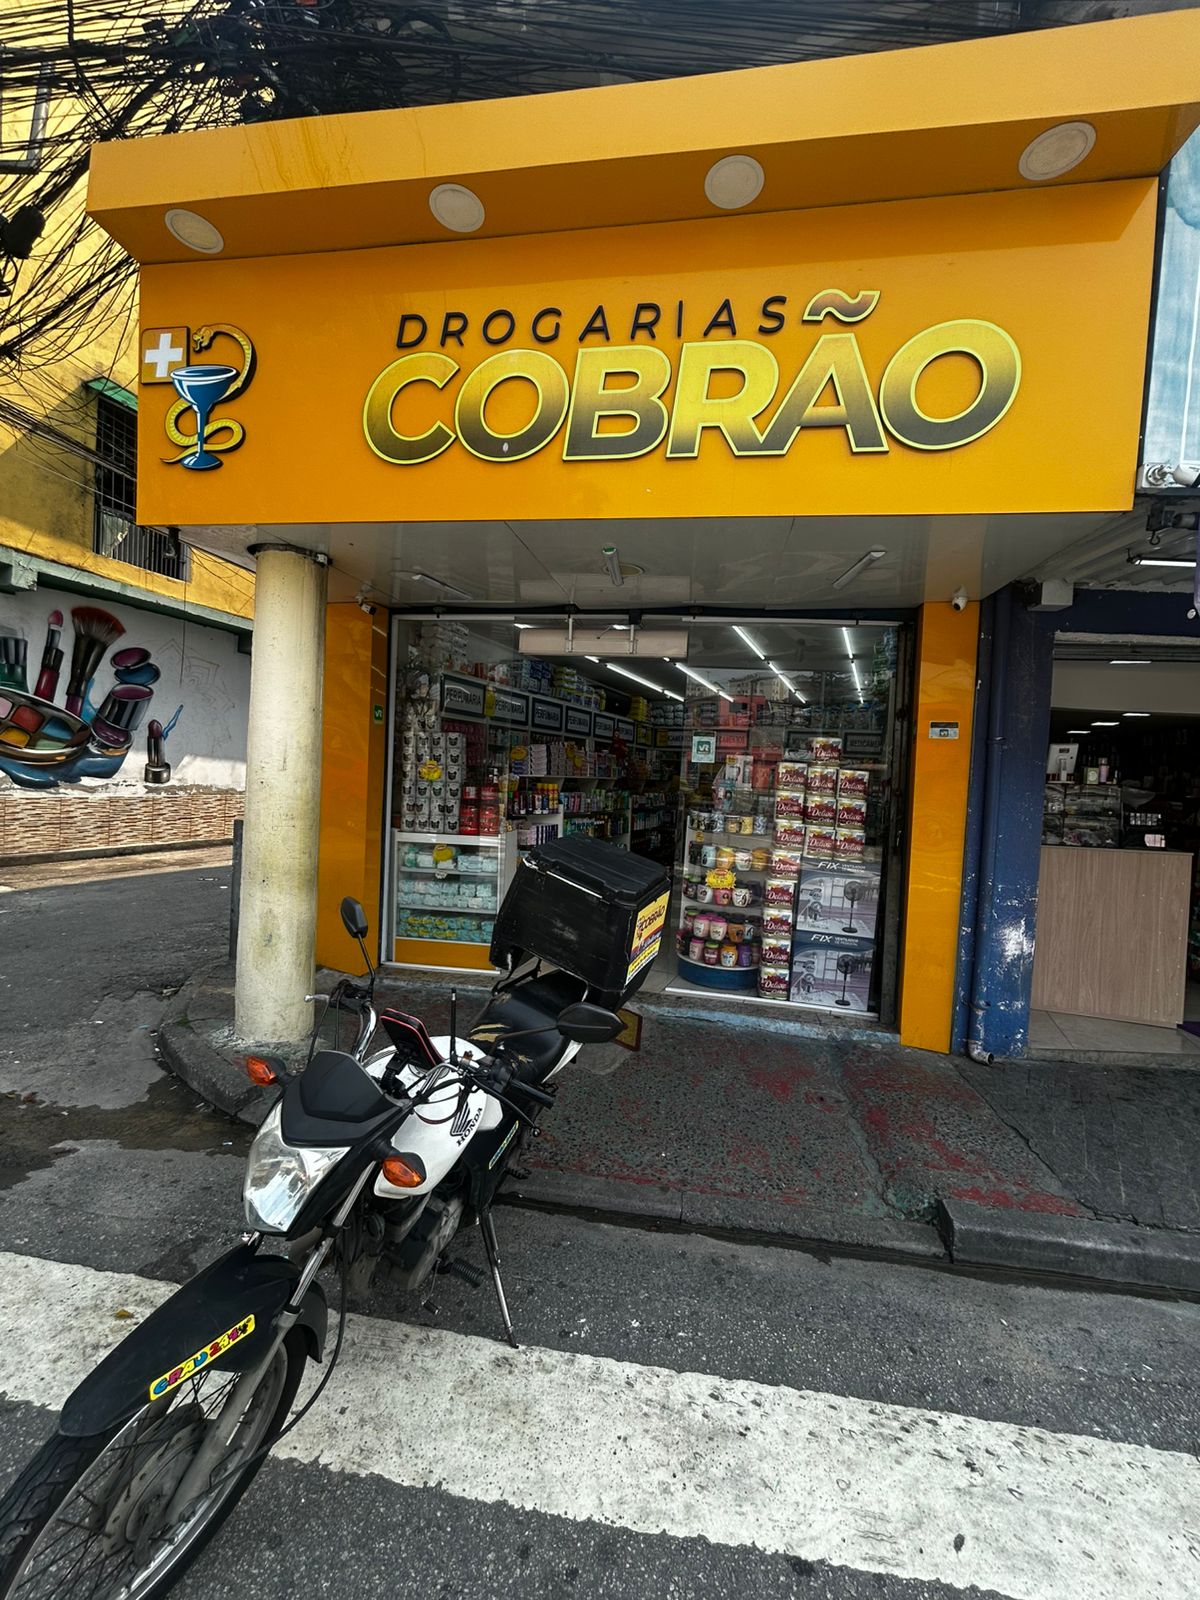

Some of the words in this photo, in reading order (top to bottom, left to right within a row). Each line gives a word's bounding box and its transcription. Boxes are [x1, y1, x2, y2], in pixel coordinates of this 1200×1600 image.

[395, 295, 788, 348] DROGARIAS
[362, 288, 1023, 465] COBRÃO
[817, 861, 840, 870] FIX
[811, 933, 832, 943] FIX
[456, 1107, 483, 1147] HONDA
[153, 1351, 208, 1394] GRAU
[209, 1327, 240, 1357] 244
